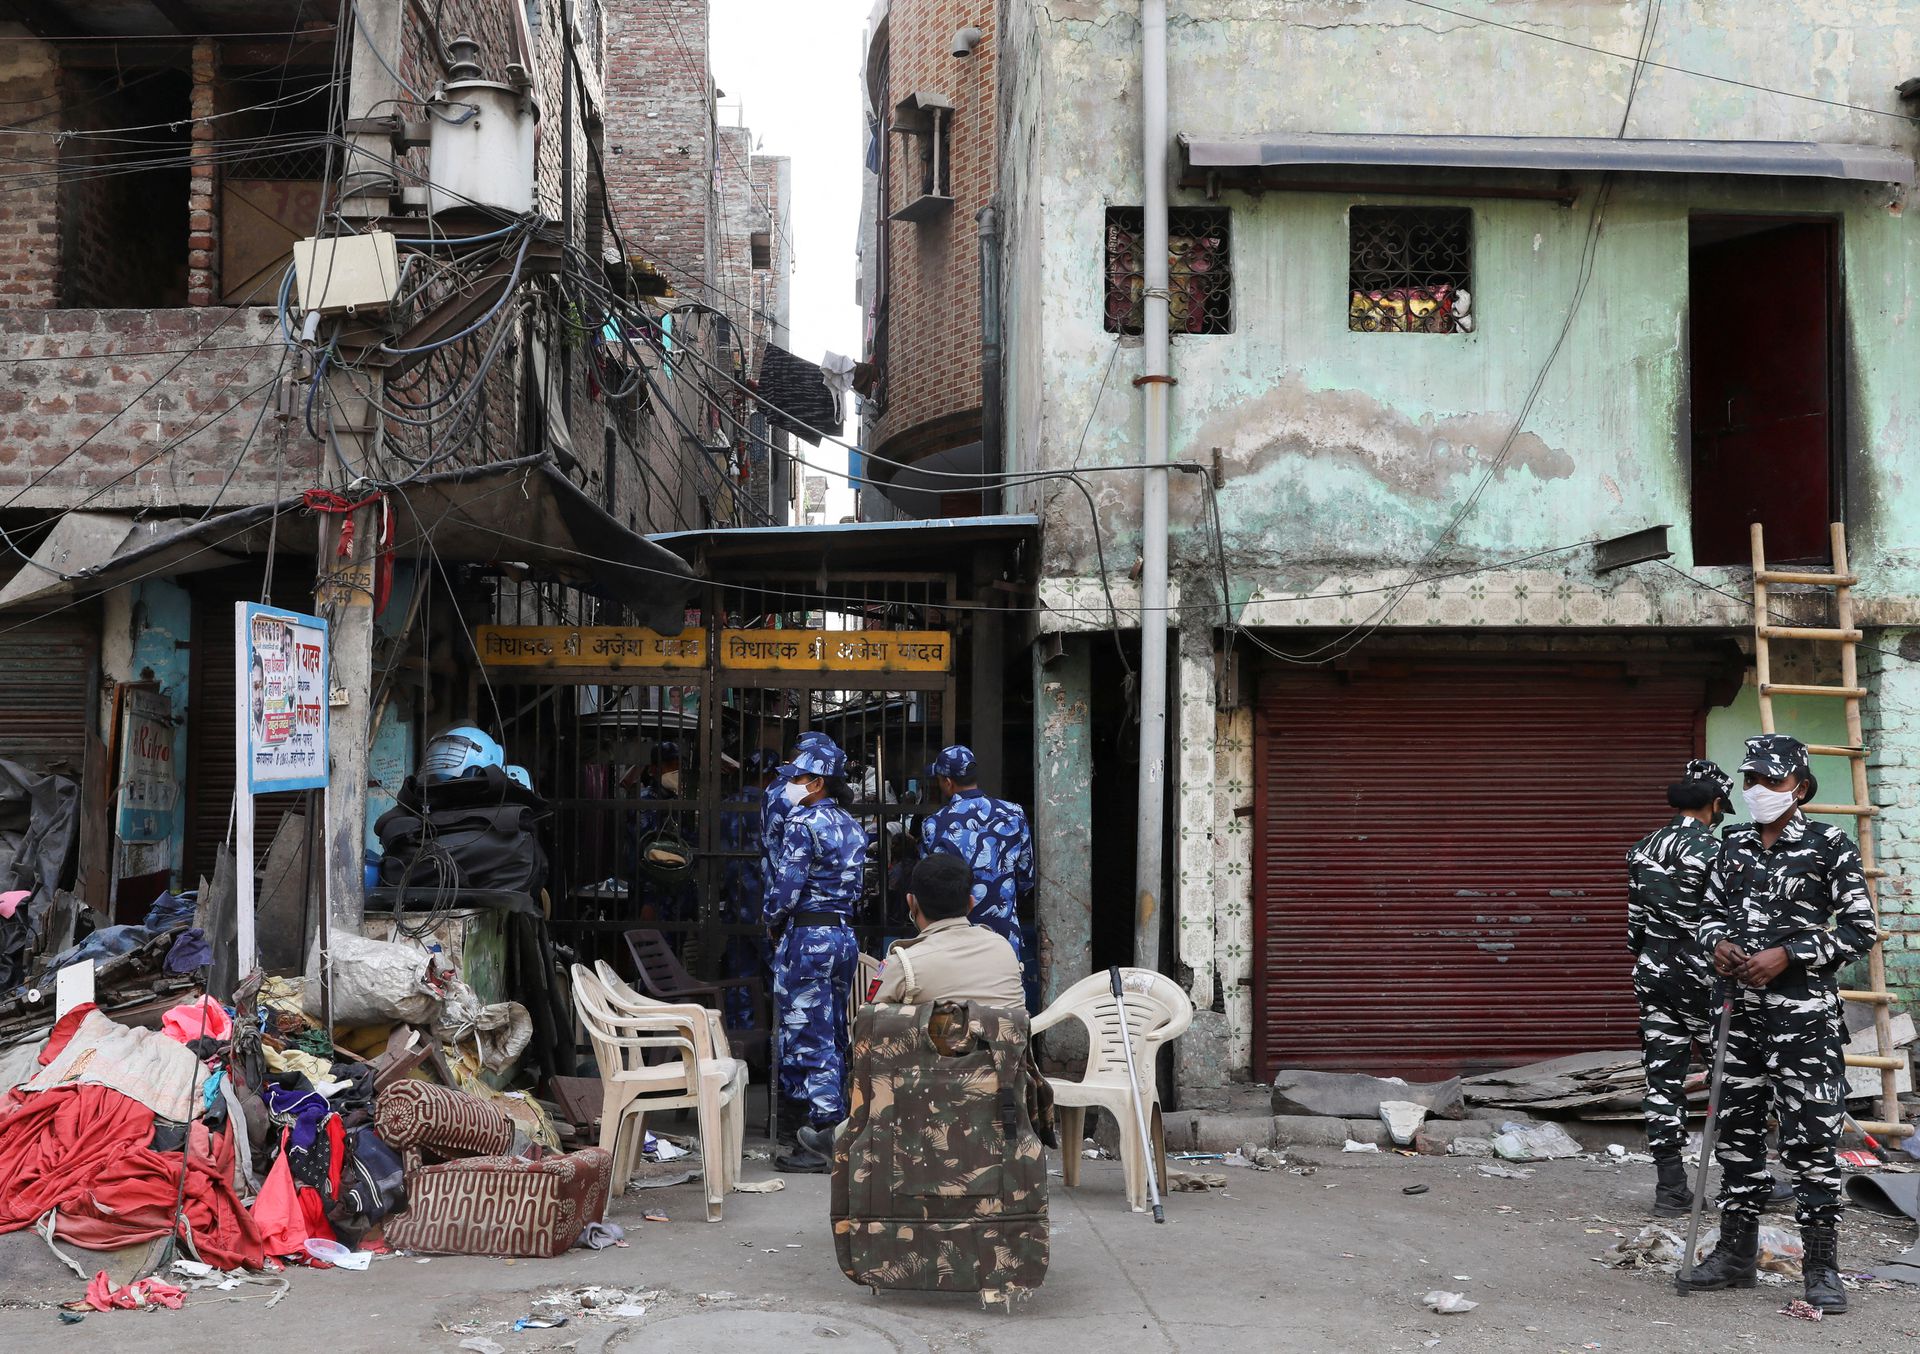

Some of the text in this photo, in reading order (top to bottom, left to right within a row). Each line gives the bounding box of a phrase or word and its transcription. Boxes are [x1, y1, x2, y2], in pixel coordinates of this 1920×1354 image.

[484, 632, 699, 658] विधायक श्री अजेश यादव
[729, 635, 945, 663] विधायक श्री अजेश यादव
